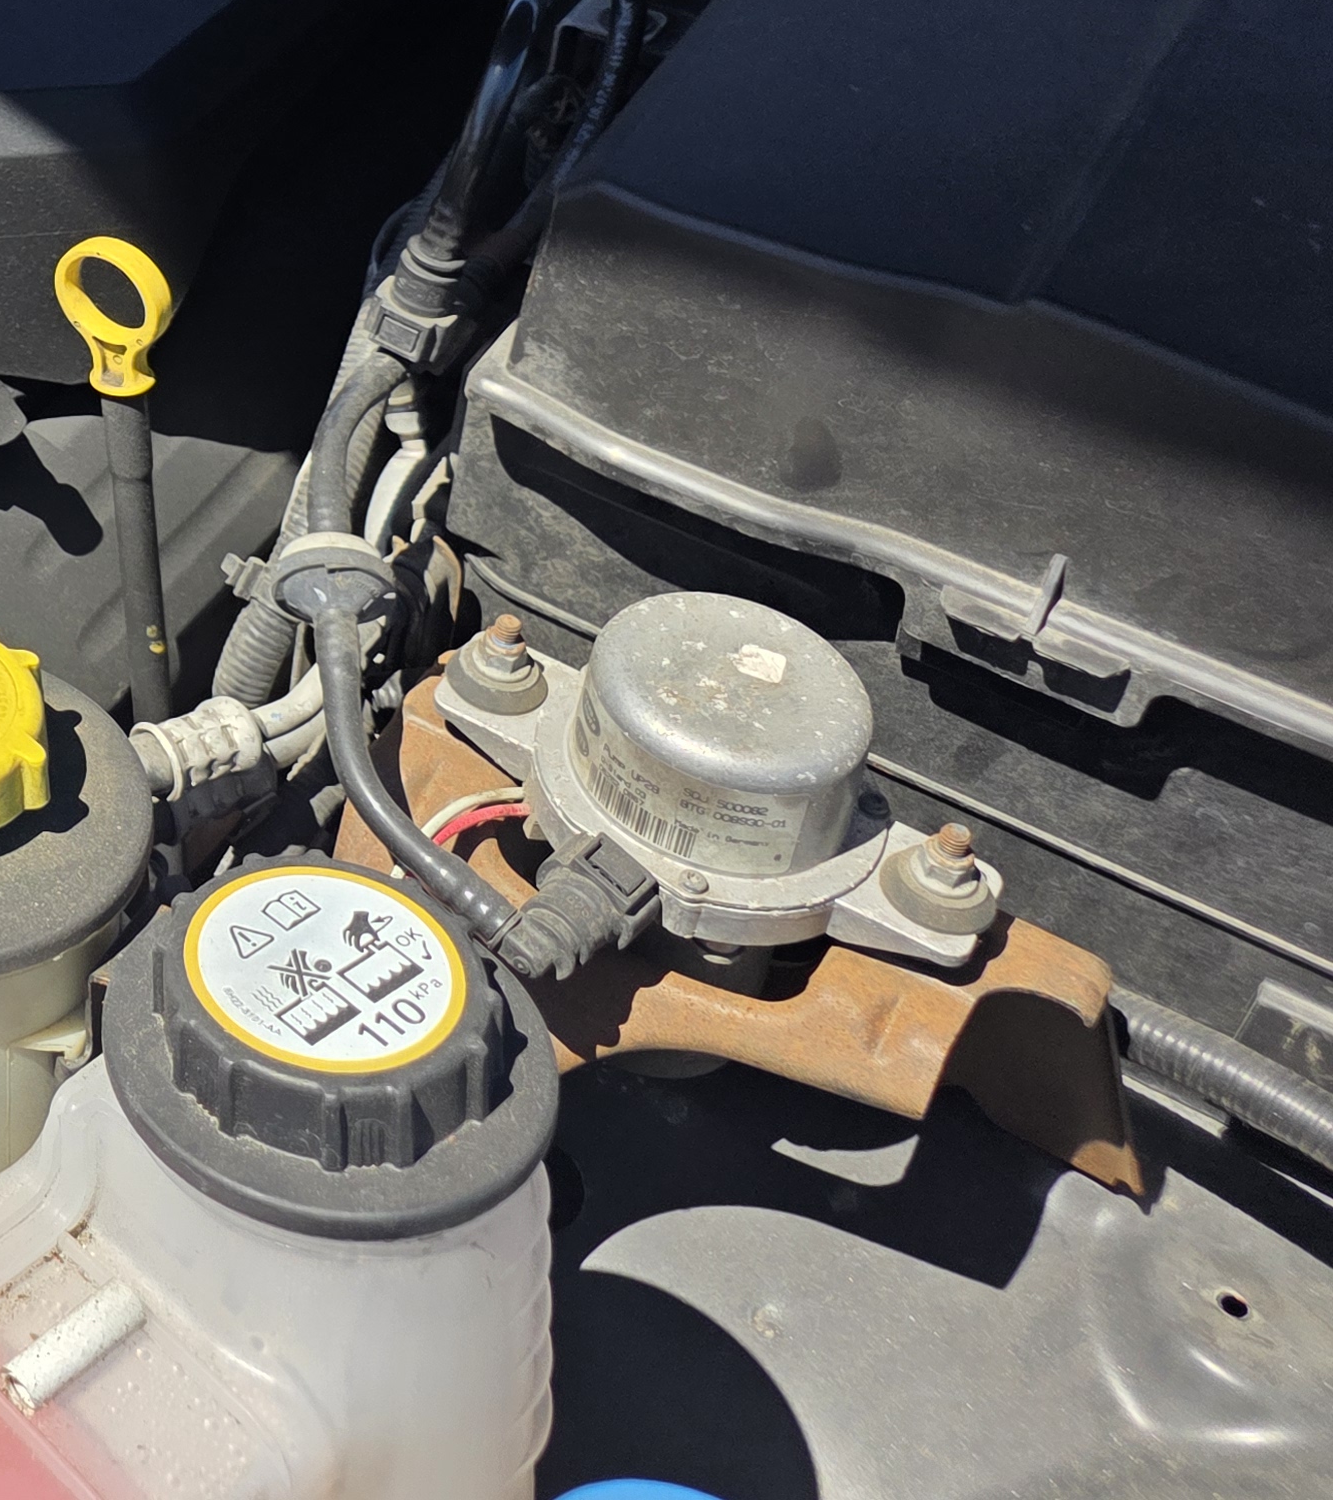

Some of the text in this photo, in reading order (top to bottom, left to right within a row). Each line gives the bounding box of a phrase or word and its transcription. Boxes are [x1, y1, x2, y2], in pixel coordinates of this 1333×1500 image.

[396, 928, 423, 948] OK
[409, 978, 443, 1001] kPa
[358, 997, 427, 1047] 110
